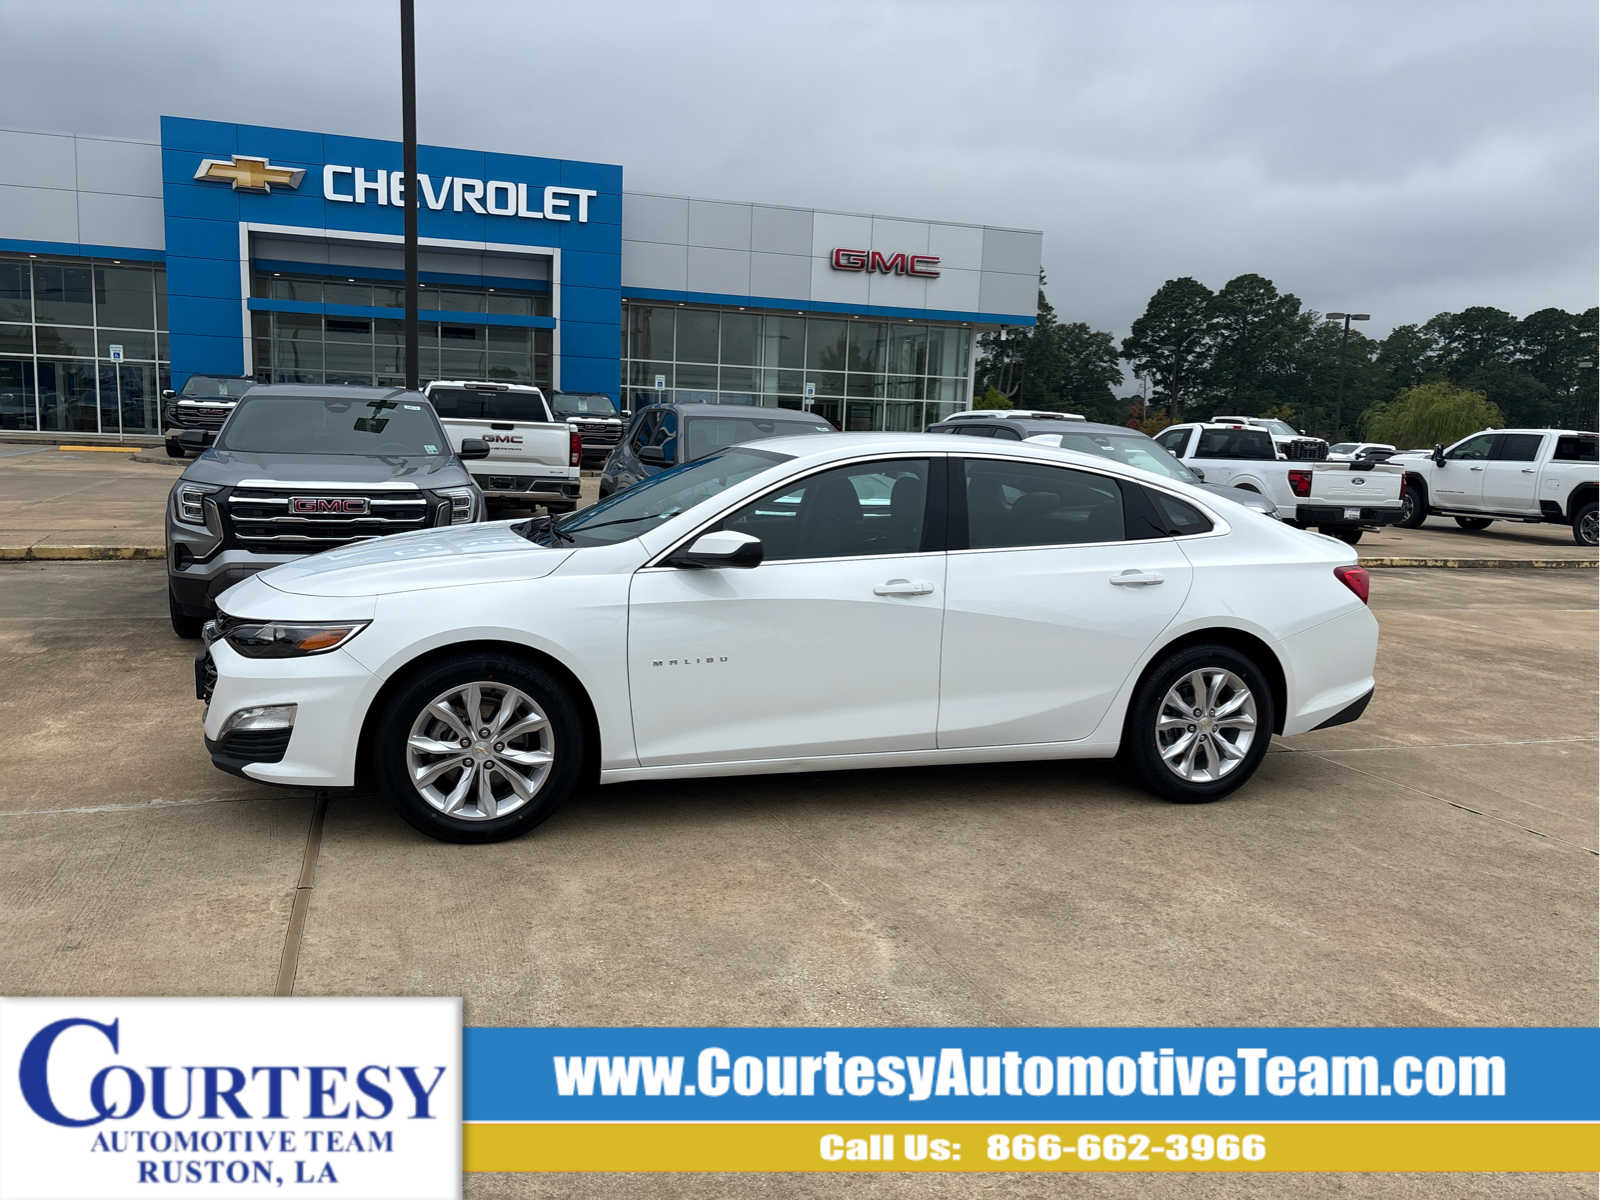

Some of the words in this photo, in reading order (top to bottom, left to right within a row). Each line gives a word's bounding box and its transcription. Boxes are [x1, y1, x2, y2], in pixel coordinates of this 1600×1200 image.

[323, 164, 597, 223] CHEVROLET
[831, 248, 941, 278] GMC
[482, 435, 523, 443] GMC
[294, 499, 365, 513] GMC
[652, 656, 728, 667] MALIBU
